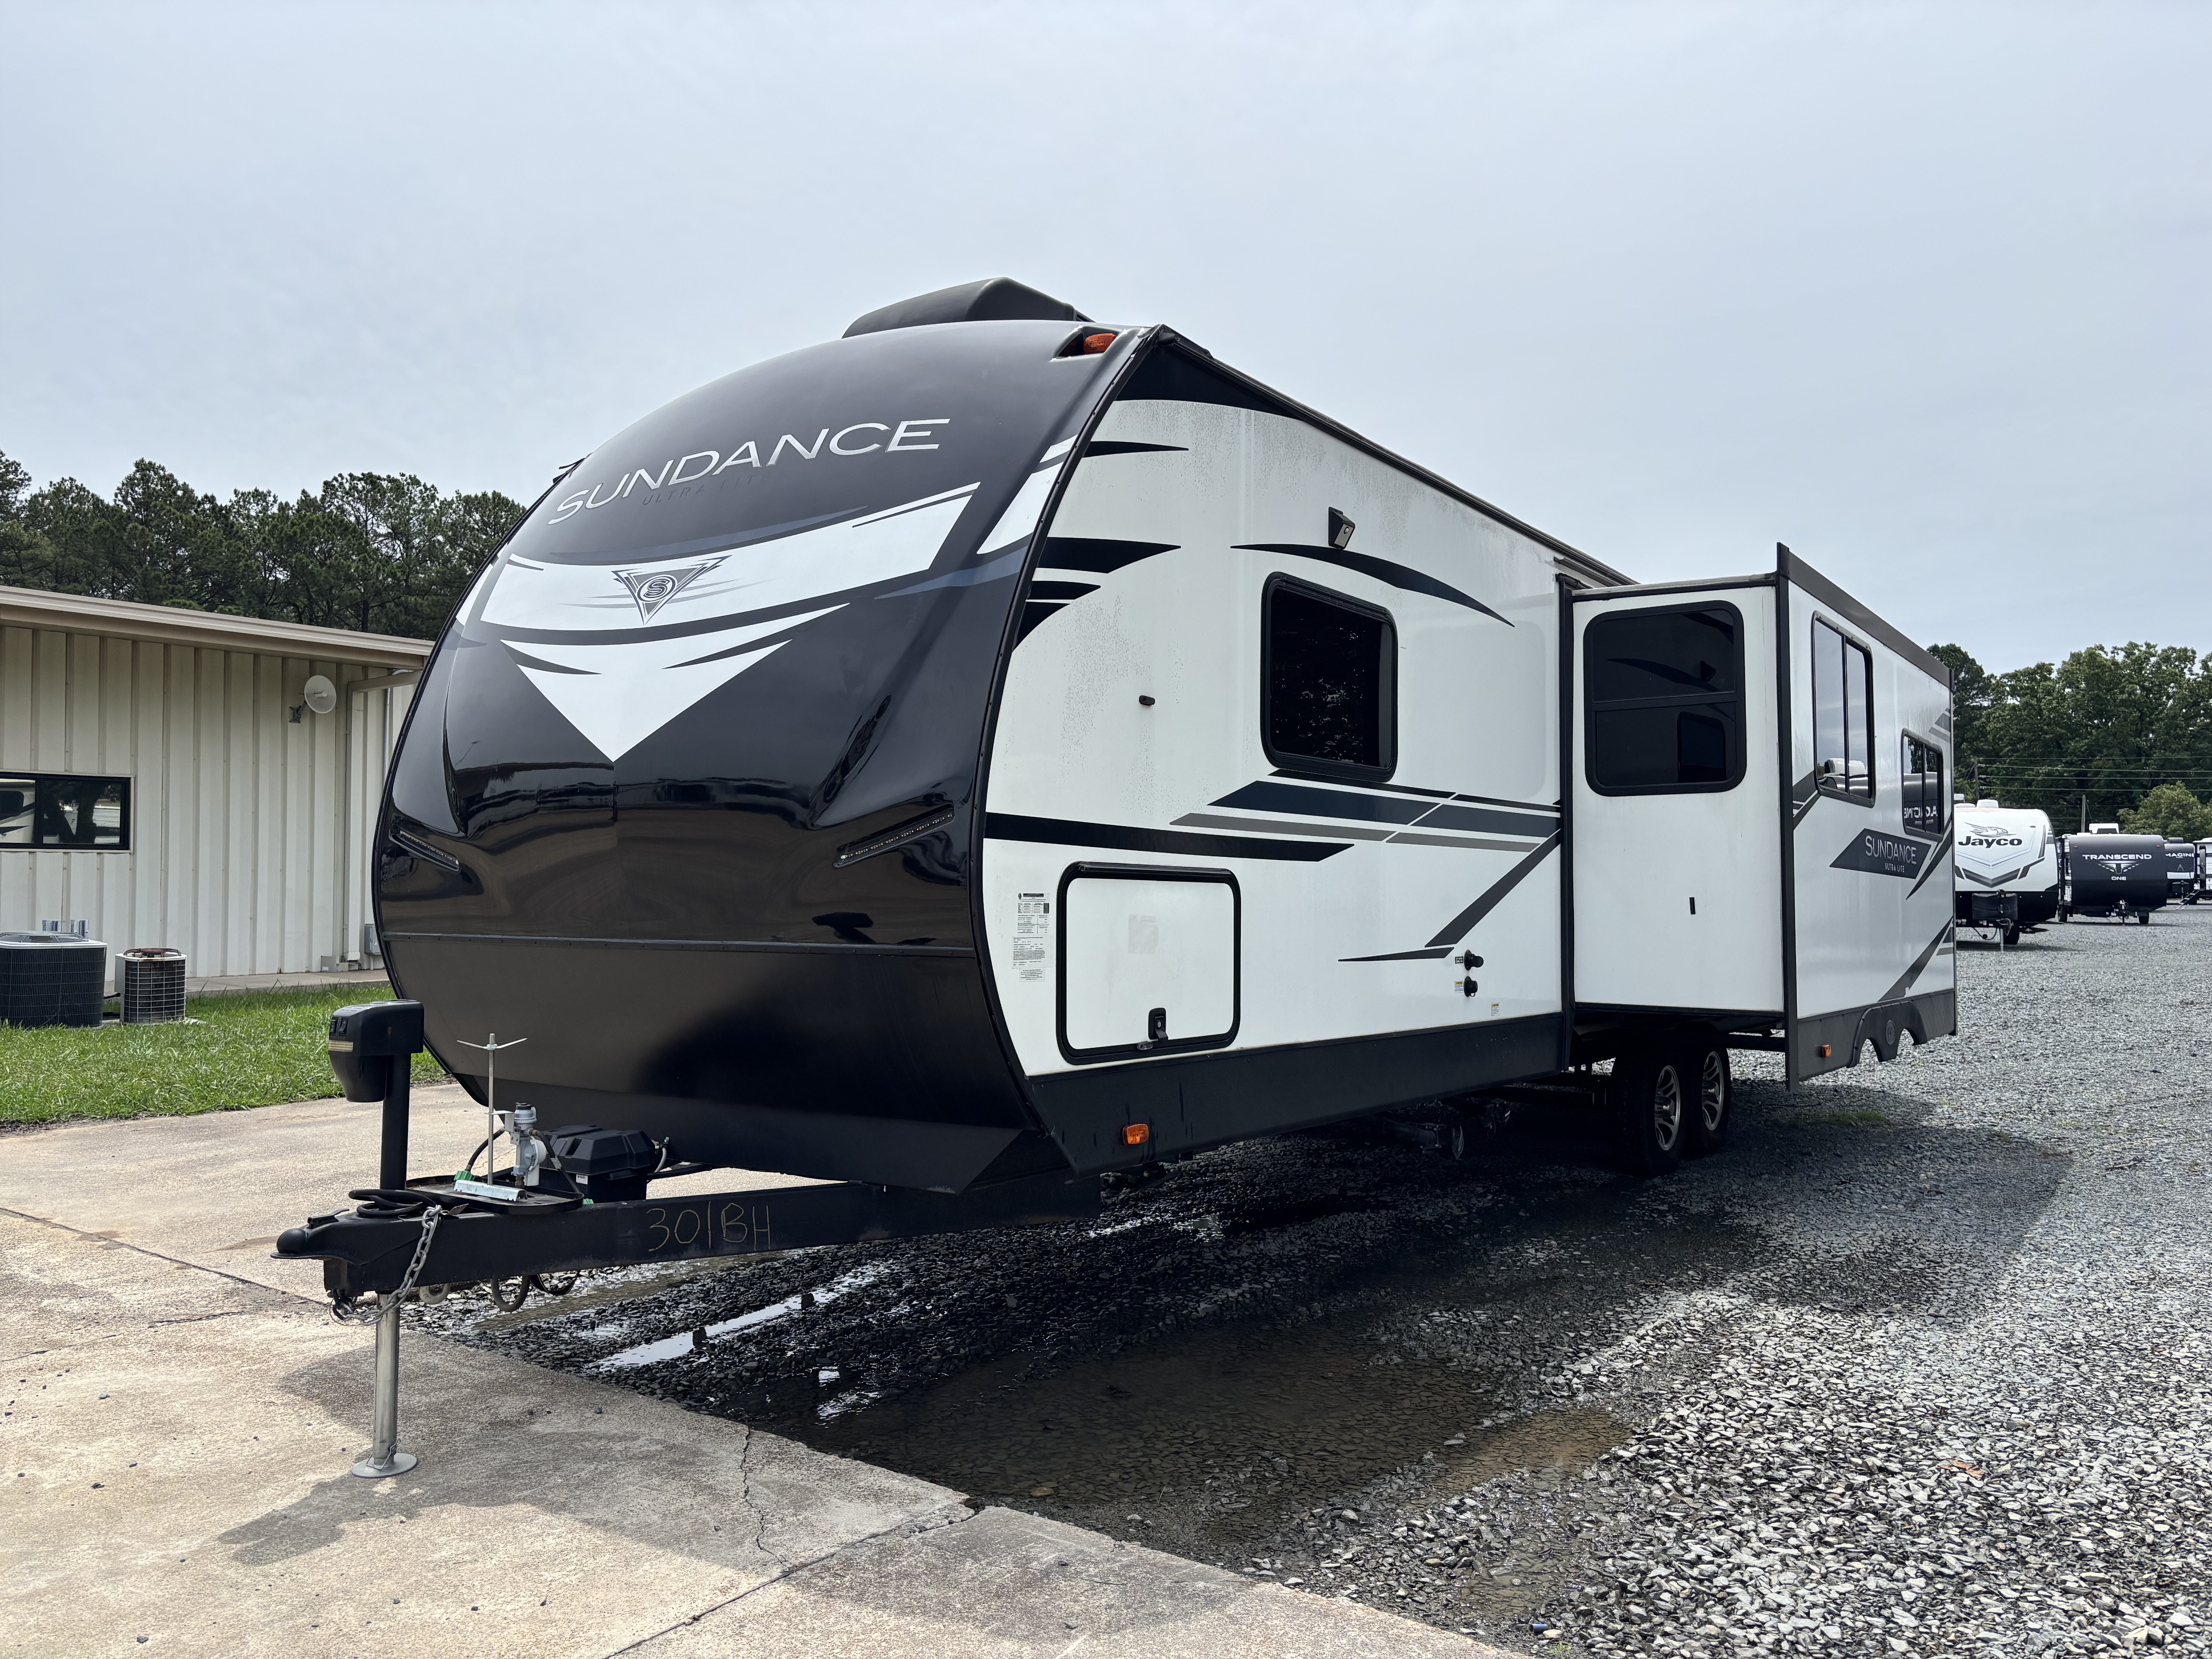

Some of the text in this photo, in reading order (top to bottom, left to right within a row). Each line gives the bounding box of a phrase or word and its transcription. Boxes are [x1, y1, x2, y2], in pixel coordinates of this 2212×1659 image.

[547, 418, 950, 525] SUNDANCE
[642, 484, 704, 505] ULTRA
[1865, 835, 1917, 865] SUNDANCE
[1958, 836, 2022, 848] Jayco
[1885, 862, 1896, 871] ULTRA
[646, 1200, 771, 1252] 301BH
